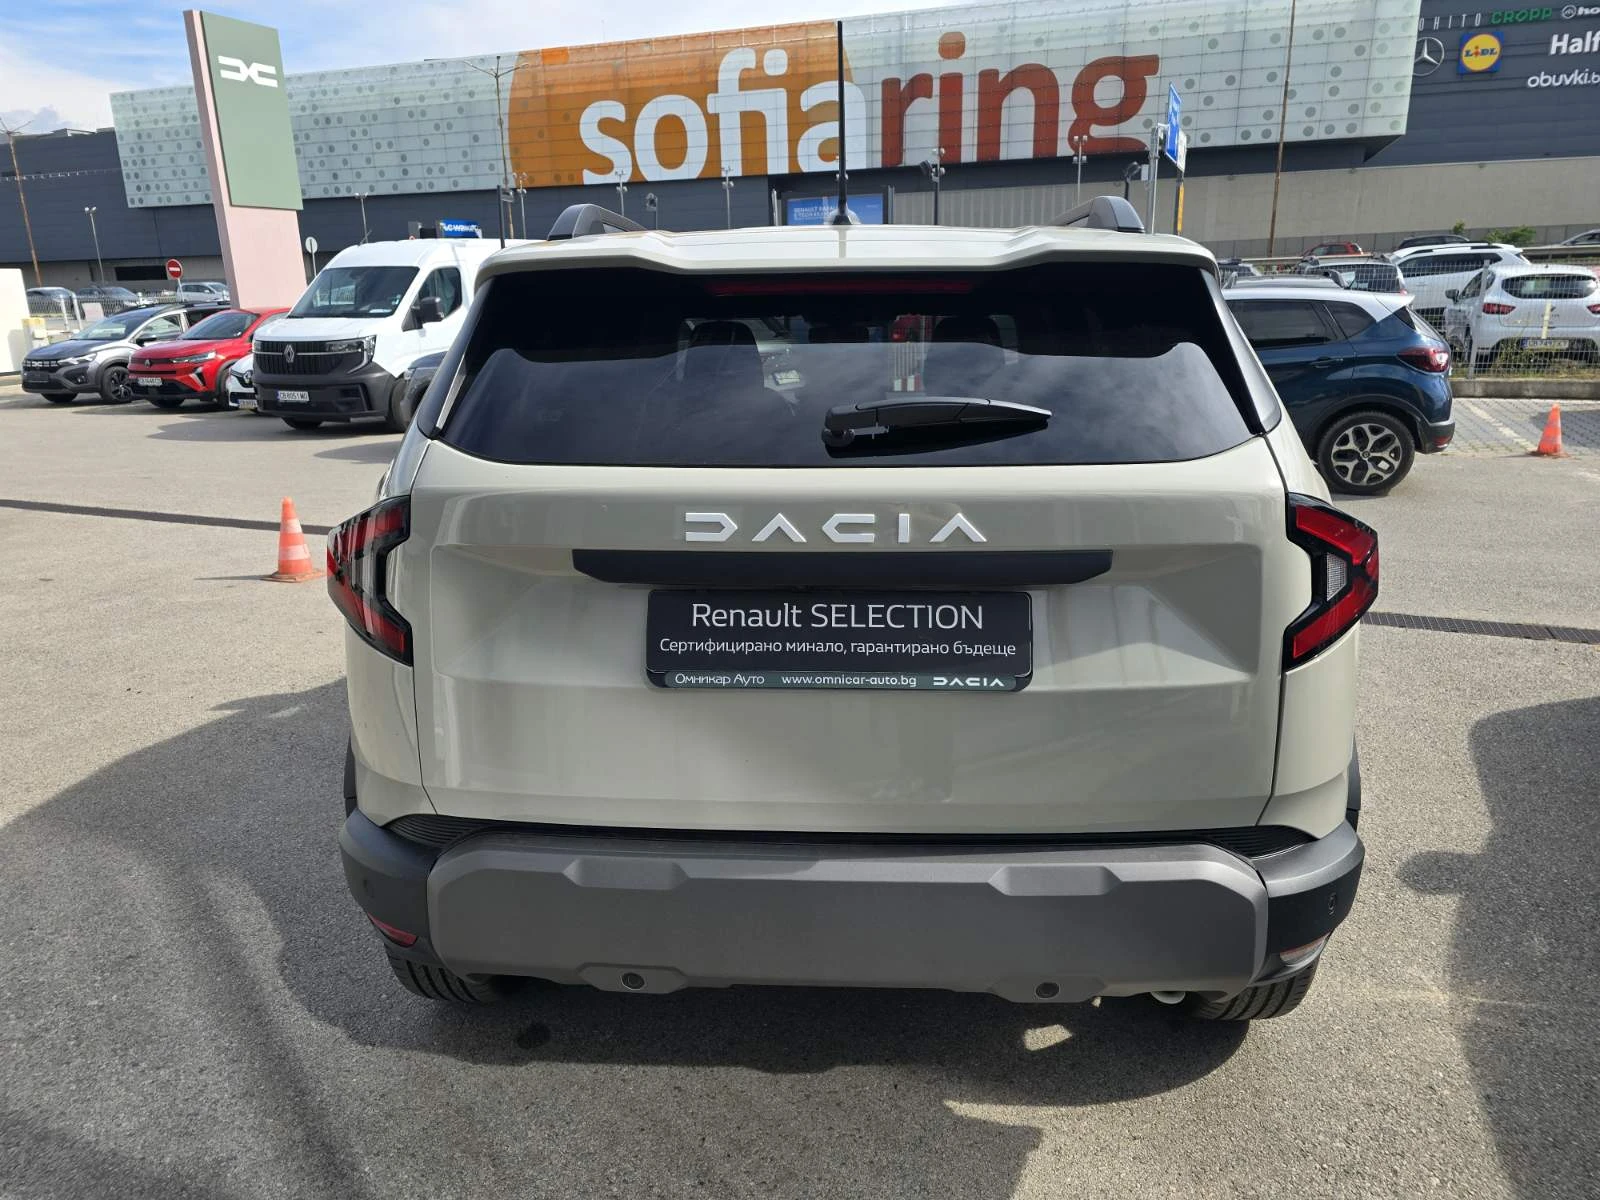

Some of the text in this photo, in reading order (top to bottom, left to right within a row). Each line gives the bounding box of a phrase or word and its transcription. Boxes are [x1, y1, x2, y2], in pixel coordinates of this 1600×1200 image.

[1491, 8, 1552, 24] CROPP
[685, 512, 988, 543] DACIA
[692, 602, 983, 630] Renault SELECTION
[660, 638, 1016, 656] Сертифицирано минало, гарантирано бъдеще
[674, 673, 765, 686] Омникар Ауто
[781, 674, 917, 688] www.omnicar-auto.bg
[933, 676, 1005, 687] DACIA
